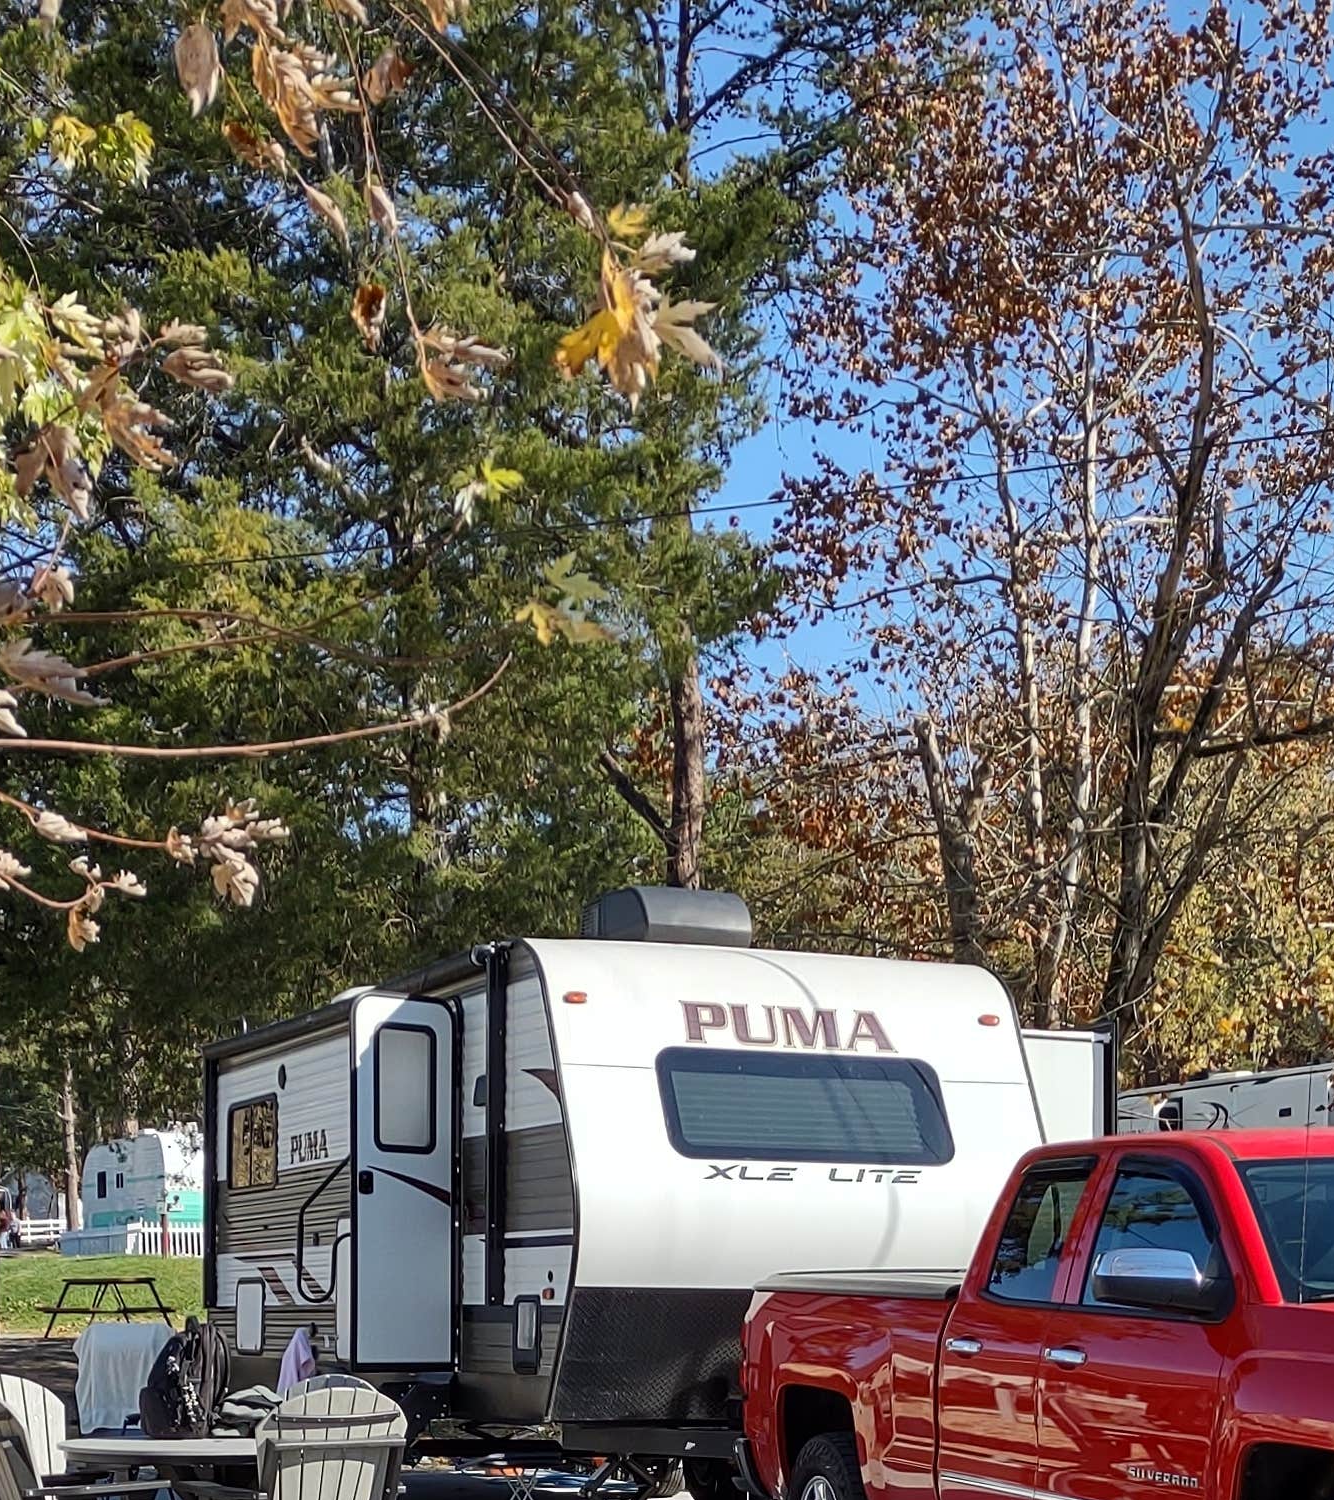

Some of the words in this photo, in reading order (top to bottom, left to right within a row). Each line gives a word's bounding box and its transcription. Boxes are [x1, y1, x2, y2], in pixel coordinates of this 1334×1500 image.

[679, 1000, 898, 1053] PUMA
[290, 1129, 329, 1165] PUMA
[704, 1165, 798, 1181] XLE
[828, 1168, 922, 1183] LITE
[1128, 1466, 1199, 1488] SILVERADO
